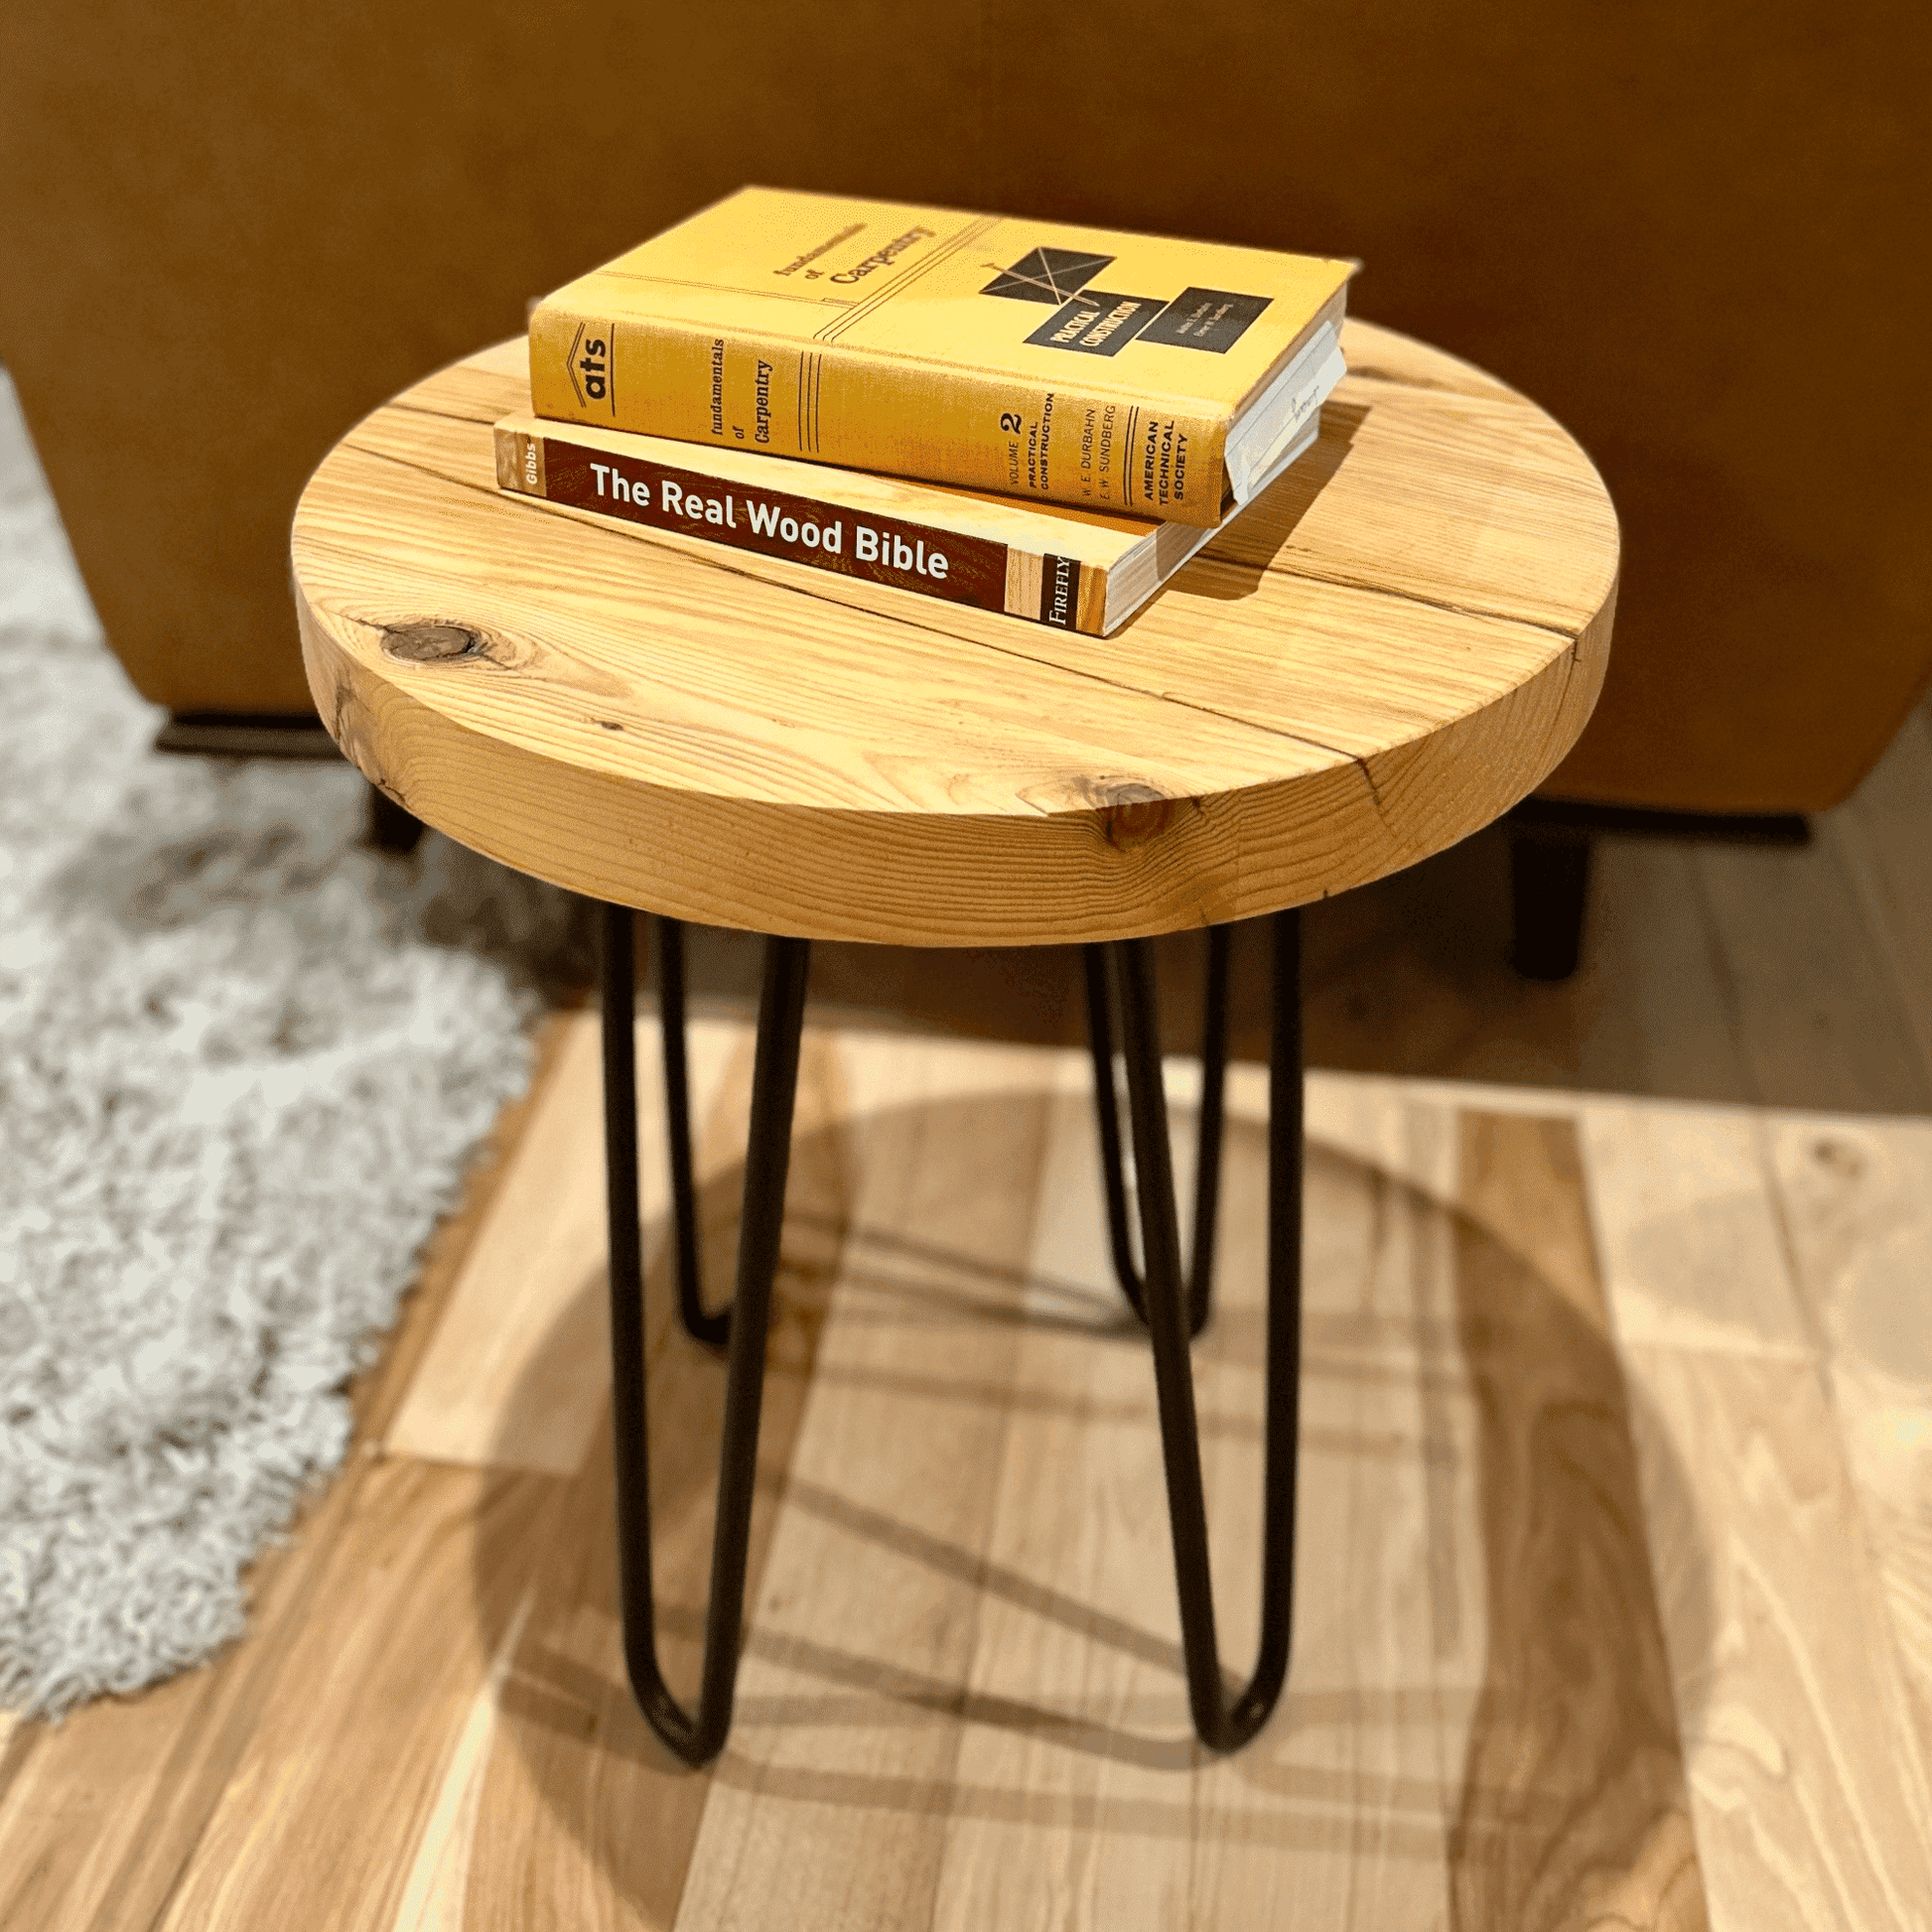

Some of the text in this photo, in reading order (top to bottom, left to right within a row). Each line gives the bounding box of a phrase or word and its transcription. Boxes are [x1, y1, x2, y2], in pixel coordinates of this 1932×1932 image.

[1049, 310, 1101, 344] PRACTICAL
[1078, 301, 1142, 346] CONSTRUCTION
[580, 339, 607, 400] ats
[710, 339, 725, 436] fundamentals
[755, 359, 773, 444] Carpentry
[525, 443, 538, 484] Gibbs
[732, 425, 745, 440] of
[1000, 412, 1023, 485] VOLUME 2
[1027, 421, 1038, 489] PRACTICAL
[1039, 392, 1055, 490] CONSTRUCTION
[1080, 408, 1096, 470] DURBAHN
[1098, 405, 1116, 473] SUNDBERG
[1144, 420, 1159, 501] AMERICAN
[1159, 420, 1174, 506] TECHNICAL
[1173, 433, 1188, 501] SOCIETY
[590, 463, 949, 580] The Real Wood Bible
